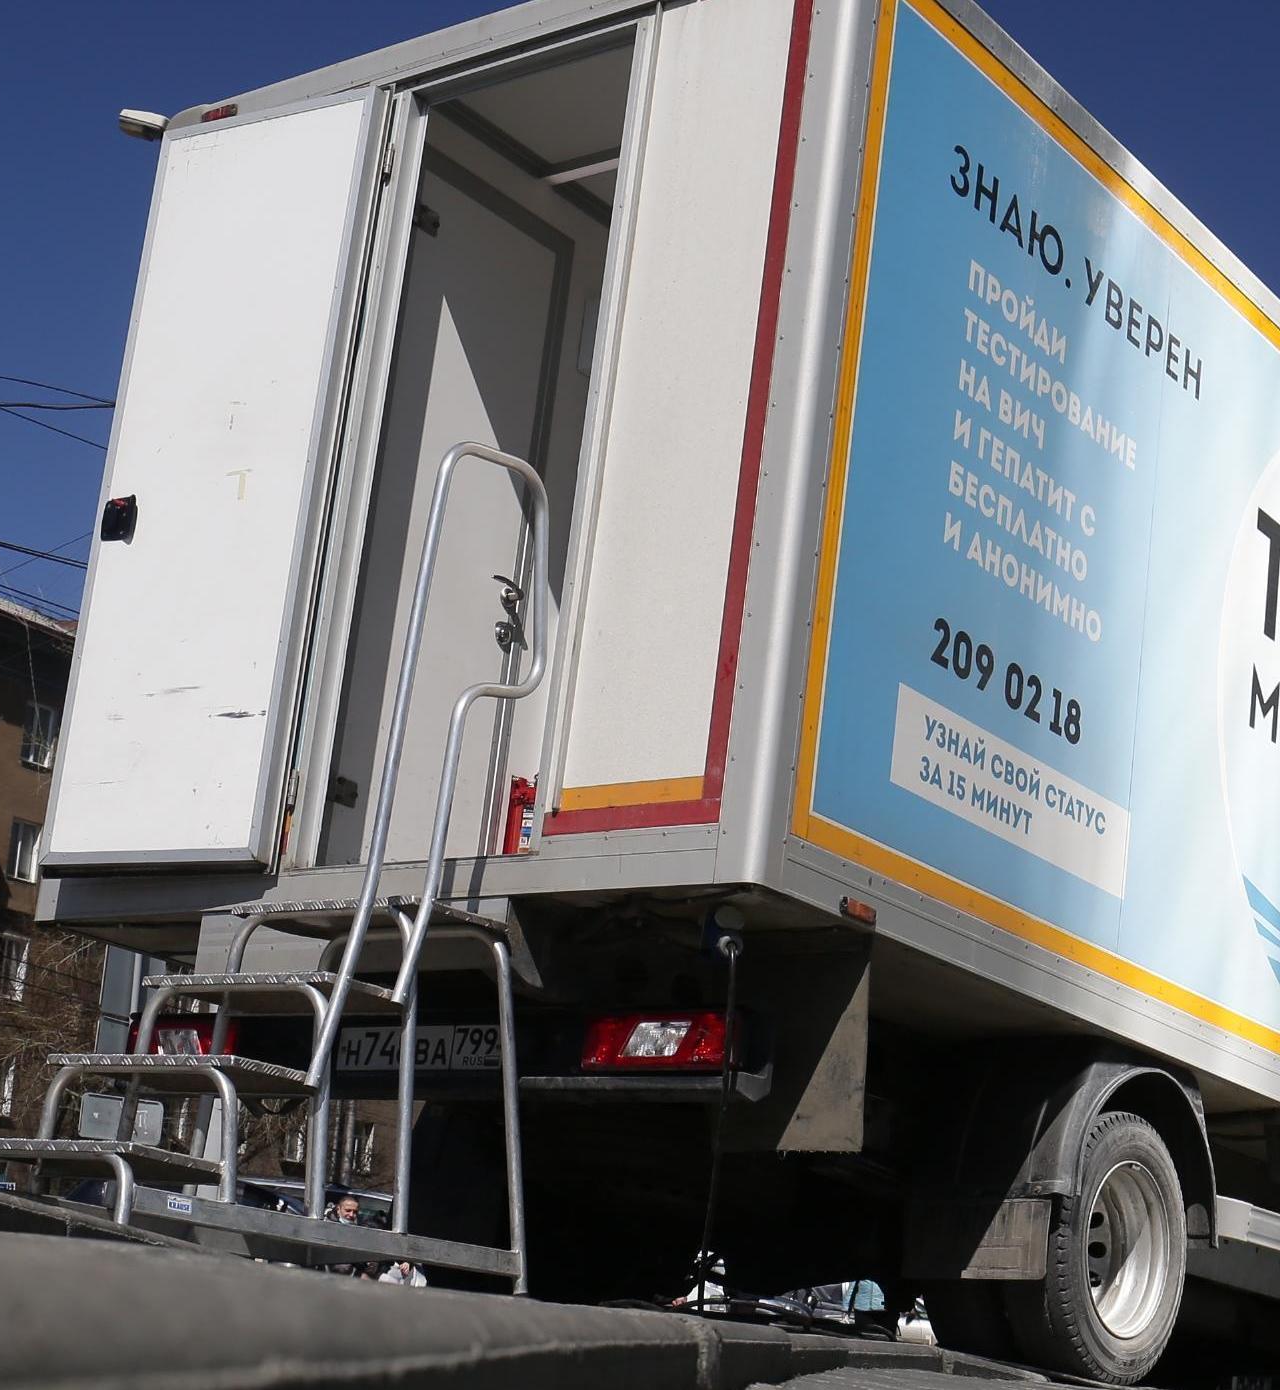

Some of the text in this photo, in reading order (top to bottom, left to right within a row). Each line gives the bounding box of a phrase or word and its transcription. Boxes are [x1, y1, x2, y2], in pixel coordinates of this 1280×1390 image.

[950, 144, 1203, 401] ЗНАЮ. УВЕРЕН
[968, 259, 1067, 365] ПРОЙДИ
[958, 358, 1045, 451] НА ВИЧ
[963, 306, 1137, 471] ТЕСТИРОВАНИЕ
[948, 460, 1088, 581] БЕСПЛАТНО
[953, 409, 1096, 537] И ГЕПАТИТ С
[943, 511, 1102, 642] И АНОНИМНО
[929, 617, 1081, 745] 209 02 18
[919, 756, 1033, 835] ЗА 15 МИНУТ
[924, 714, 1106, 835] УЗНАЙ СВОЙ СТАТУС
[345, 1027, 498, 1066] Н74ВА 799
[462, 1056, 483, 1067] RUS
